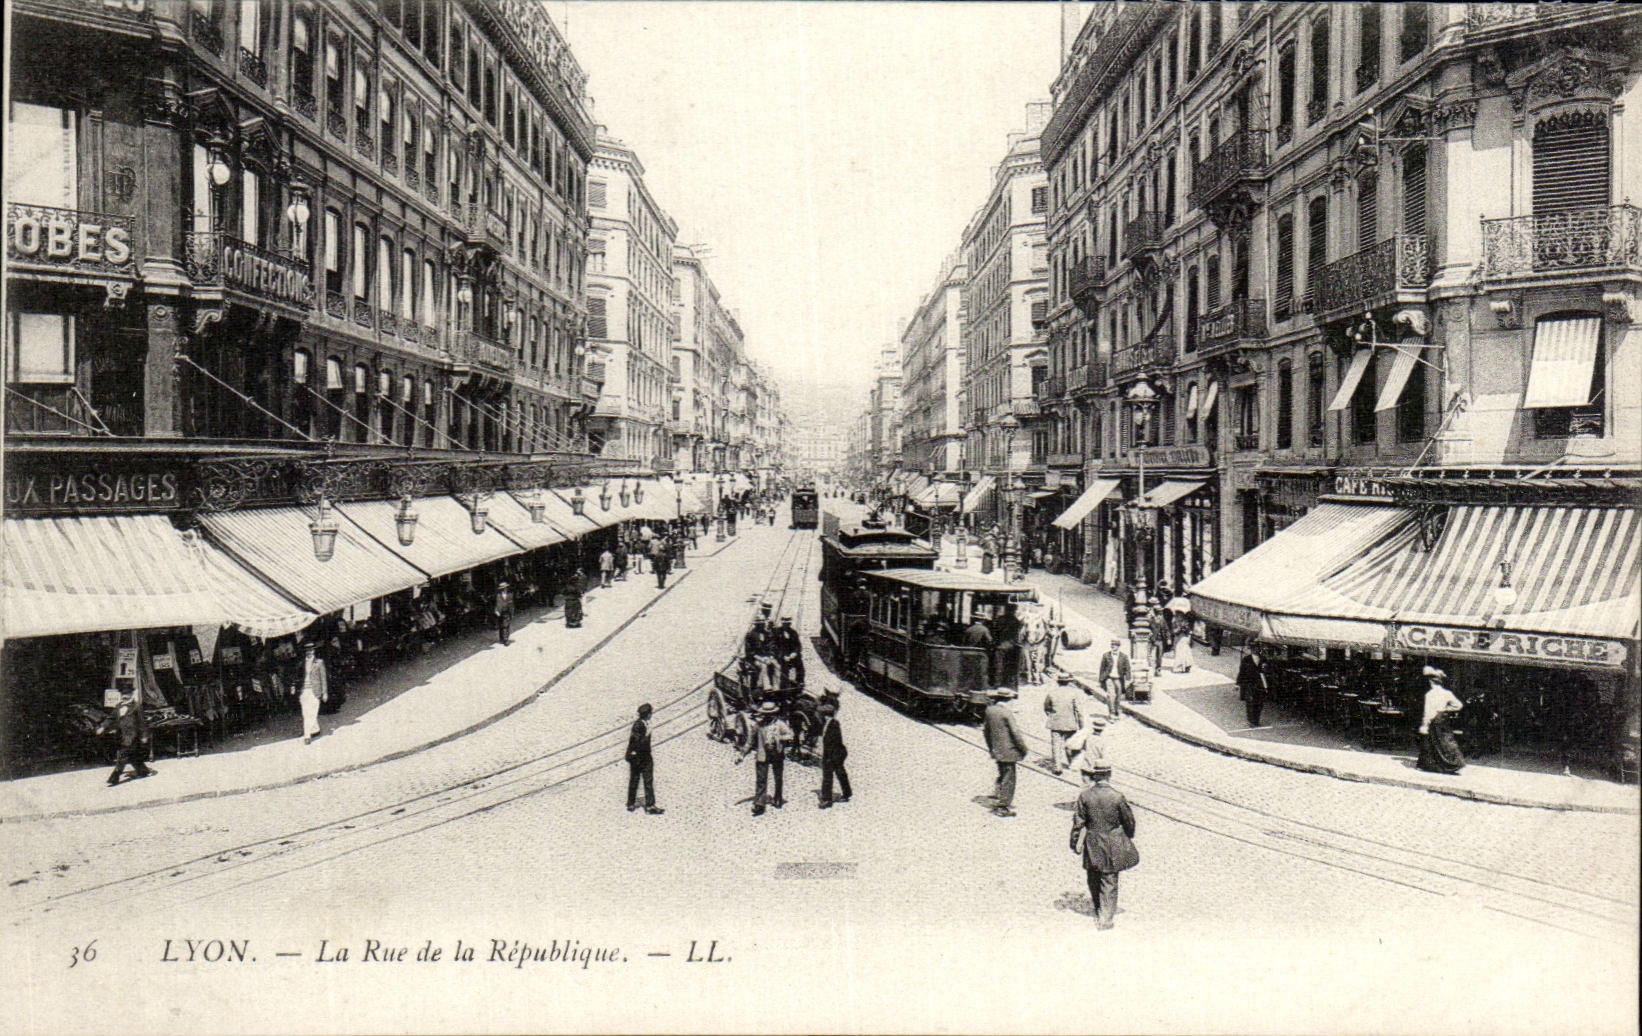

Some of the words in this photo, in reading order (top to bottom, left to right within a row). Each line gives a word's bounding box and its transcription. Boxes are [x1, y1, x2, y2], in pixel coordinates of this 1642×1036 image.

[15, 217, 130, 265] OBES
[50, 473, 176, 501] PASSAGES
[1500, 634, 1609, 661] RICHE
